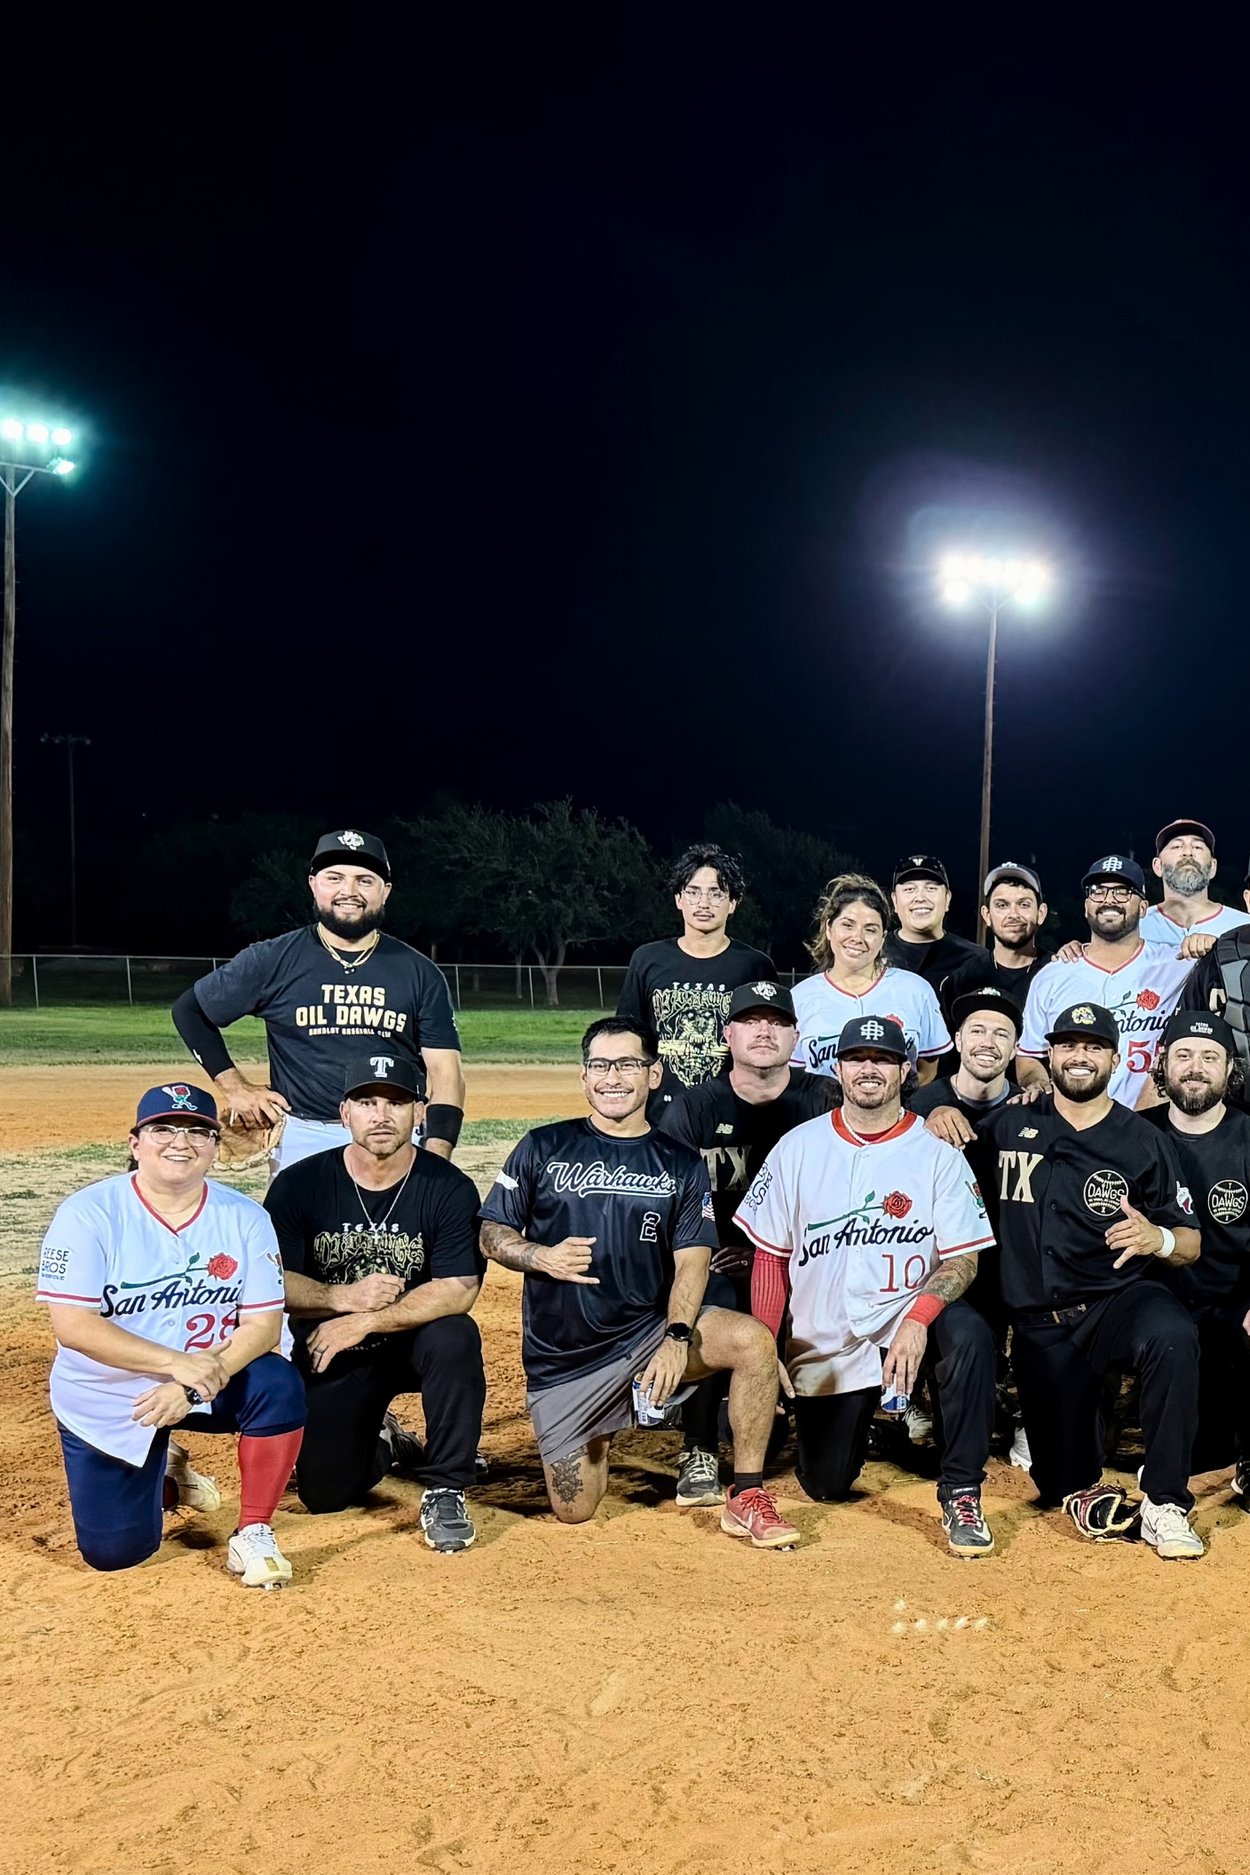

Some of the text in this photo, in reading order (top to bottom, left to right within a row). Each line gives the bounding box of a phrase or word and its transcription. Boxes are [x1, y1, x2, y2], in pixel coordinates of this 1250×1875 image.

[321, 984, 385, 1006] TEXAS
[672, 981, 726, 991] TEXAS
[295, 1005, 408, 1033] OIL DAWGS
[369, 1056, 394, 1078] T
[808, 1039, 838, 1069] San
[1126, 1040, 1163, 1074] 5
[547, 1160, 678, 1195] Warhawks
[699, 1145, 753, 1193] TX
[998, 1150, 1045, 1204] TX
[1087, 1183, 1126, 1203] DAWGS
[1211, 1193, 1246, 1210] DAWGS
[341, 1222, 400, 1233] TEXAS
[639, 1211, 661, 1243] 2
[799, 1217, 934, 1267] San Antonio
[879, 1254, 926, 1293] 10
[100, 1280, 243, 1318] San Antoni
